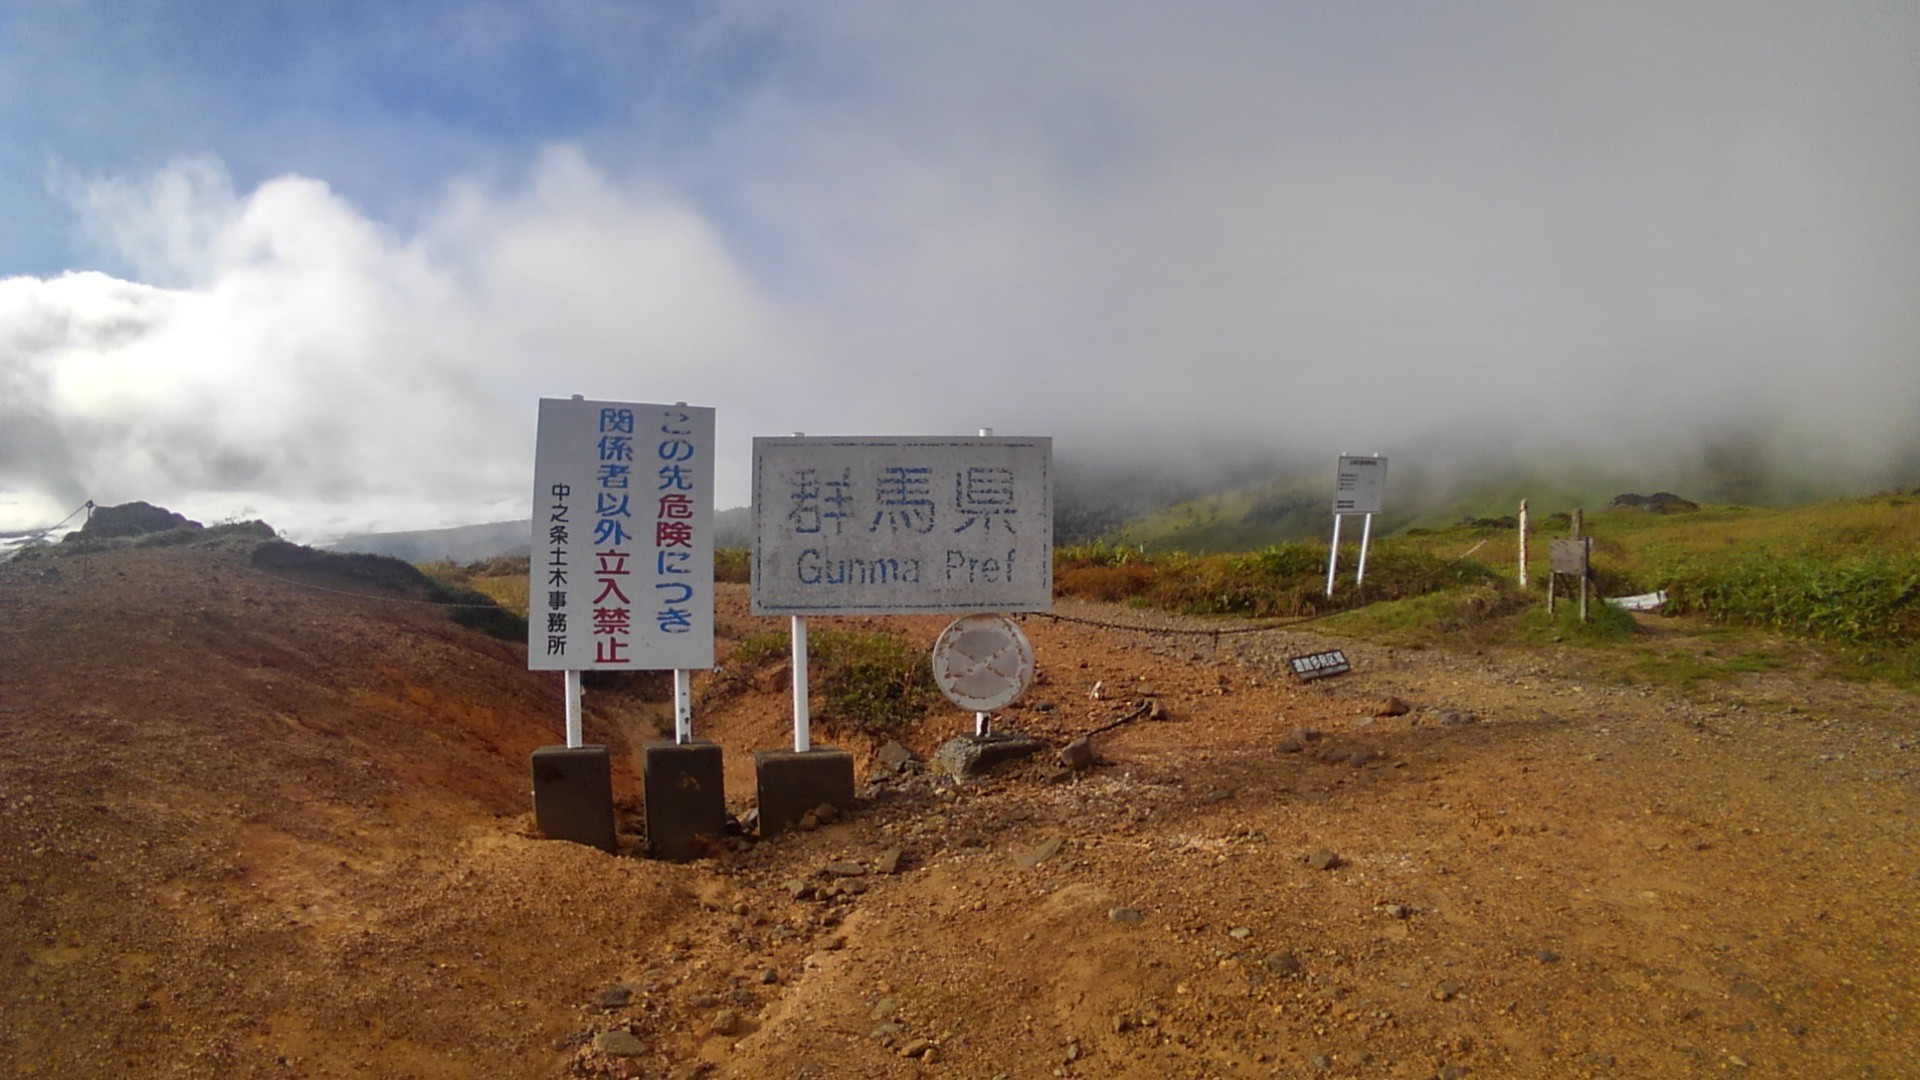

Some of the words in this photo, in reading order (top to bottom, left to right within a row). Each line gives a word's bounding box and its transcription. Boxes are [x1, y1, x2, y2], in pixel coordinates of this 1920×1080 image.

[547, 483, 570, 656] 中之条土木事務所
[592, 407, 635, 664] 関係者以外立入禁止
[655, 410, 694, 633] この先危険につき
[789, 467, 1018, 535] 群馬県
[797, 549, 920, 585] Gunma
[946, 549, 1016, 583] Pref
